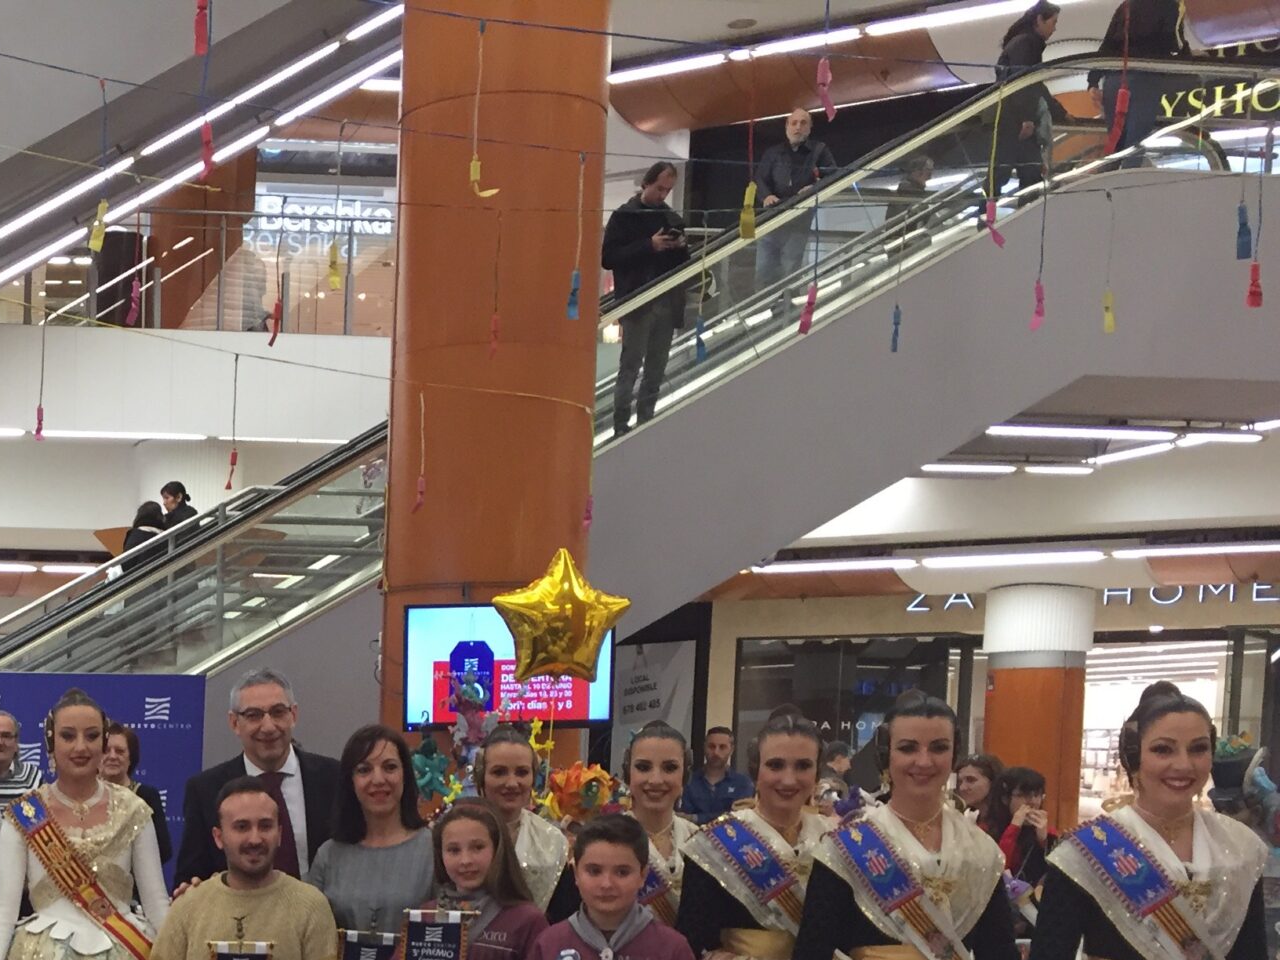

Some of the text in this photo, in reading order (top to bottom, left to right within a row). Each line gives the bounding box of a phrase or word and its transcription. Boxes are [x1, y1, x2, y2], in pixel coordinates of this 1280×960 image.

[259, 196, 392, 234] Bershka
[906, 581, 1280, 612] ZA HOME
[420, 948, 454, 958] PREMIO
